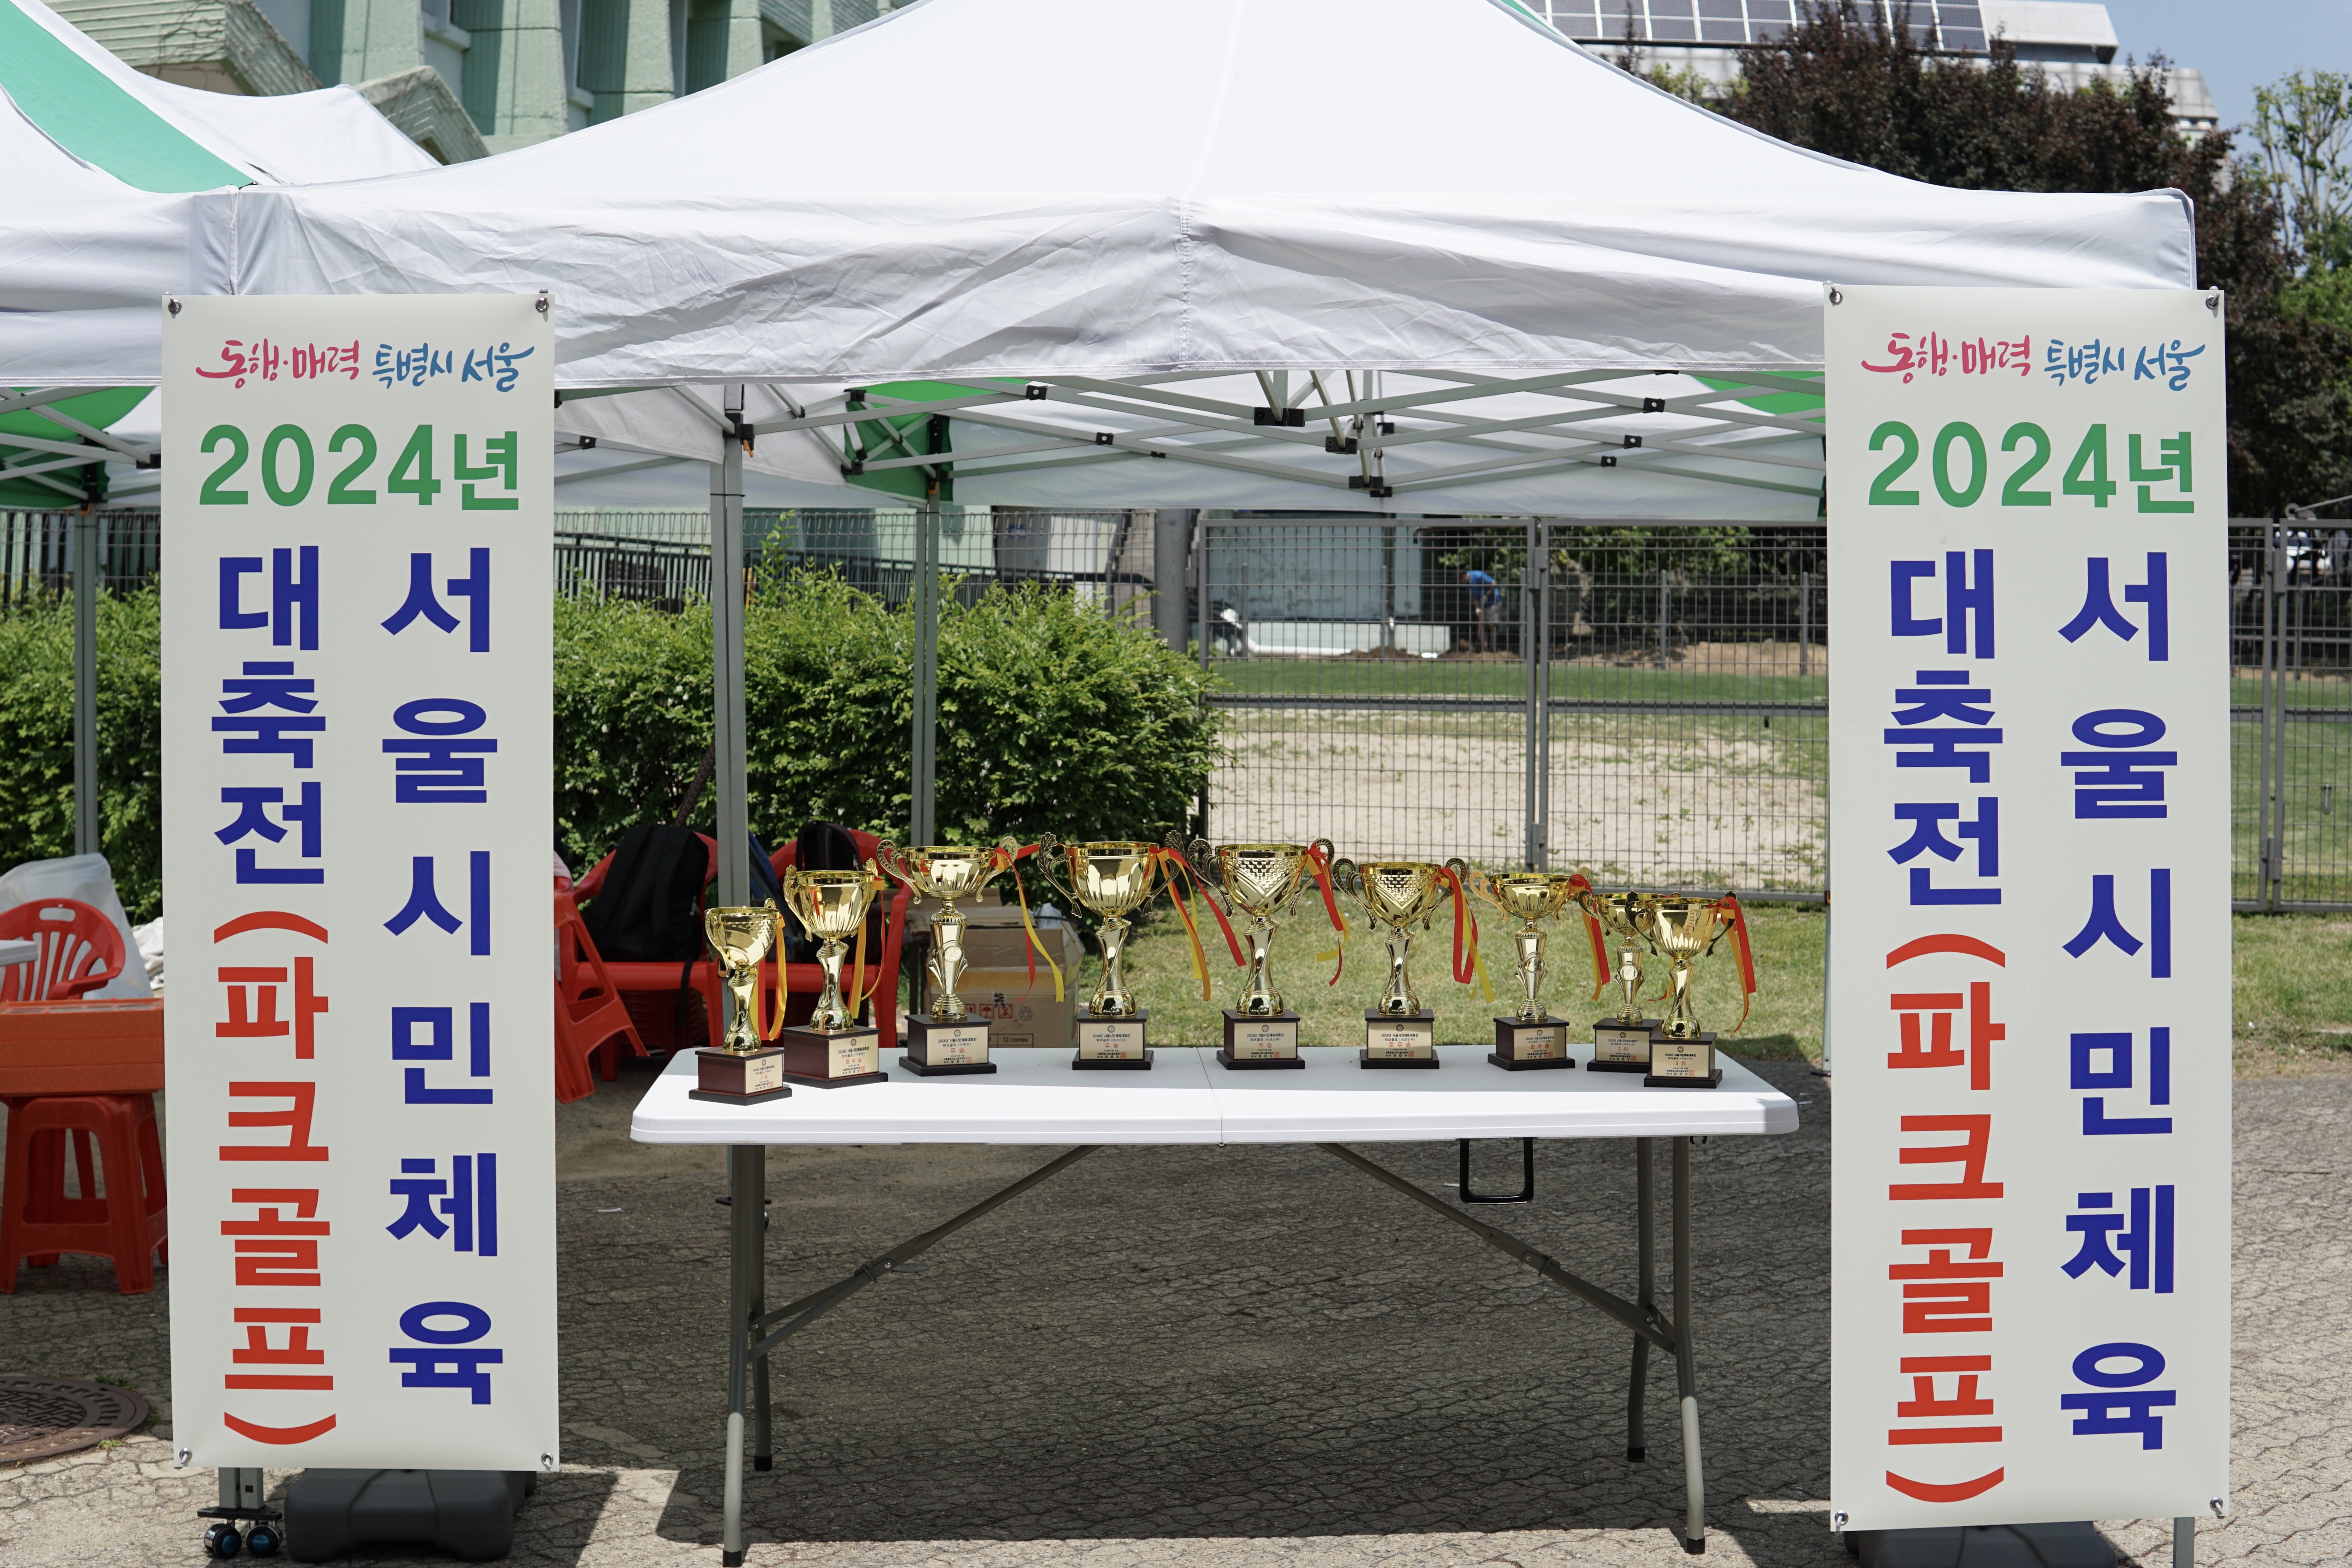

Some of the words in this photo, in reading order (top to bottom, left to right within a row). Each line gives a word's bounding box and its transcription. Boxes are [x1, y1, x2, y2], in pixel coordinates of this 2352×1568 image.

[196, 338, 359, 389] 동행·매력
[373, 343, 452, 389] 특별시
[462, 342, 534, 392] 서울
[1862, 332, 2030, 383] 동행·매력
[2044, 339, 2125, 386] 특별시
[2134, 340, 2206, 391] 서울
[199, 424, 519, 511] 2024년
[1868, 421, 2194, 513] 2024년
[381, 547, 503, 1405] 서울시민체육
[2058, 552, 2177, 1451] 서울시민체육
